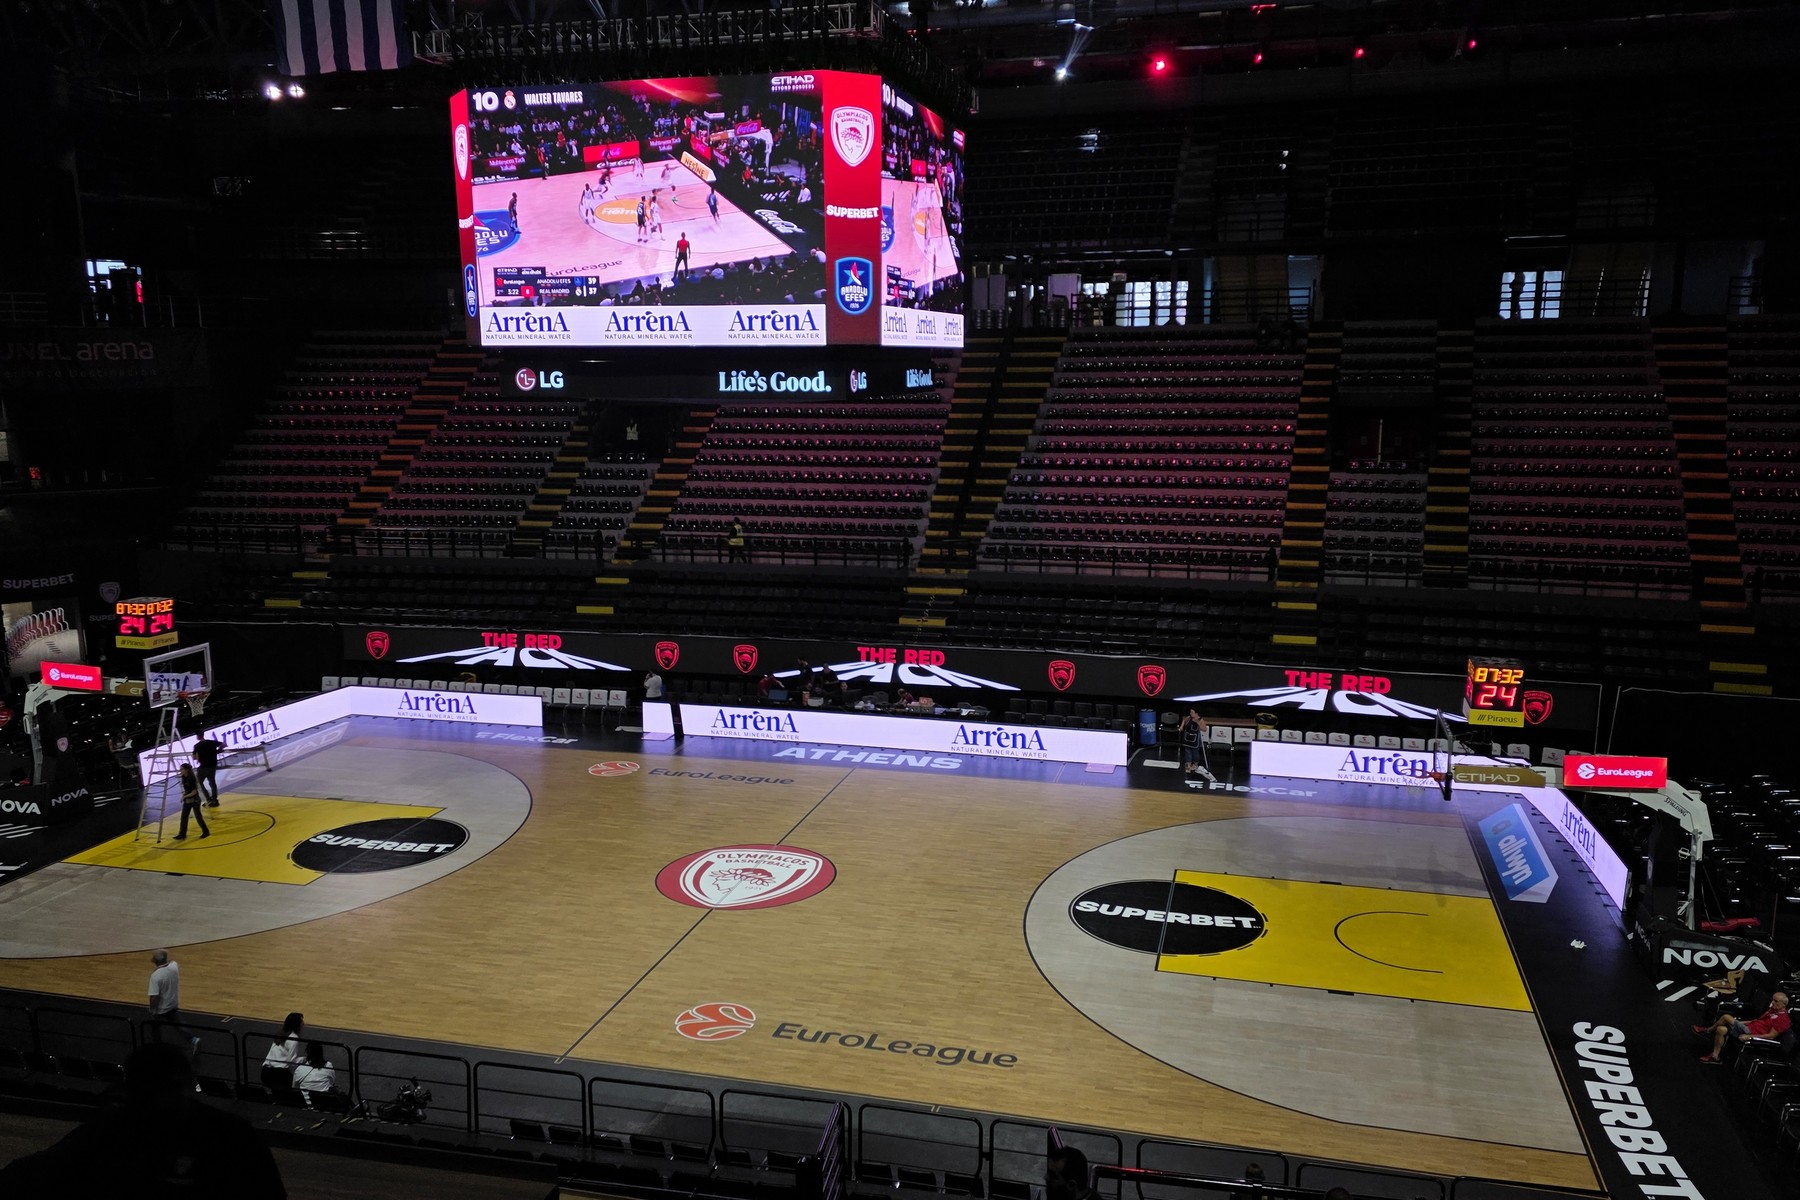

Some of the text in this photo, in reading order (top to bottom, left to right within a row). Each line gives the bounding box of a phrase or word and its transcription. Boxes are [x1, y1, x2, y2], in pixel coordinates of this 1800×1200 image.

[772, 75, 814, 84] ETIHAD
[473, 91, 583, 111] 10 WALTER TAVARES
[826, 205, 879, 219] SUPERBET
[841, 286, 868, 297] ANADOLU
[845, 293, 865, 302] EFES
[540, 371, 564, 388] LG
[719, 370, 832, 392] Life's Good.
[858, 372, 867, 389] LG
[2, 573, 75, 589] SUPERBET
[121, 613, 173, 634] 24 24
[482, 633, 562, 650] THE RED
[857, 647, 945, 667] THE RED
[1285, 670, 1391, 694] THE RED
[1475, 667, 1524, 684] 87:32
[1480, 685, 1517, 707] 24
[1487, 714, 1518, 723] Piraeus
[489, 733, 579, 744] FlexCar
[710, 729, 741, 737] NATURAL
[743, 731, 774, 739] MINERAL
[773, 747, 963, 770] ATHENS
[951, 746, 1048, 759] NATURAL MINERAL WATER
[648, 768, 795, 786] EuroLeague
[1338, 774, 1377, 783] NATURAL
[1456, 773, 1520, 784] ETIHAD
[1597, 767, 1653, 778] EuroLeague
[51, 787, 89, 807] NOVA
[1209, 782, 1318, 798] FlexCar
[0, 799, 41, 815] OVA
[309, 834, 454, 854] SUPERBET
[717, 853, 809, 866] OLYMPIACOS
[725, 859, 791, 869] BASKETBALL
[1498, 835, 1533, 885] allwyn
[1075, 900, 1256, 929] SUPERBET
[1663, 948, 1768, 973] NOVA
[772, 1023, 1018, 1068] EuroLeague
[1572, 1021, 1706, 1200] SUPERBET
